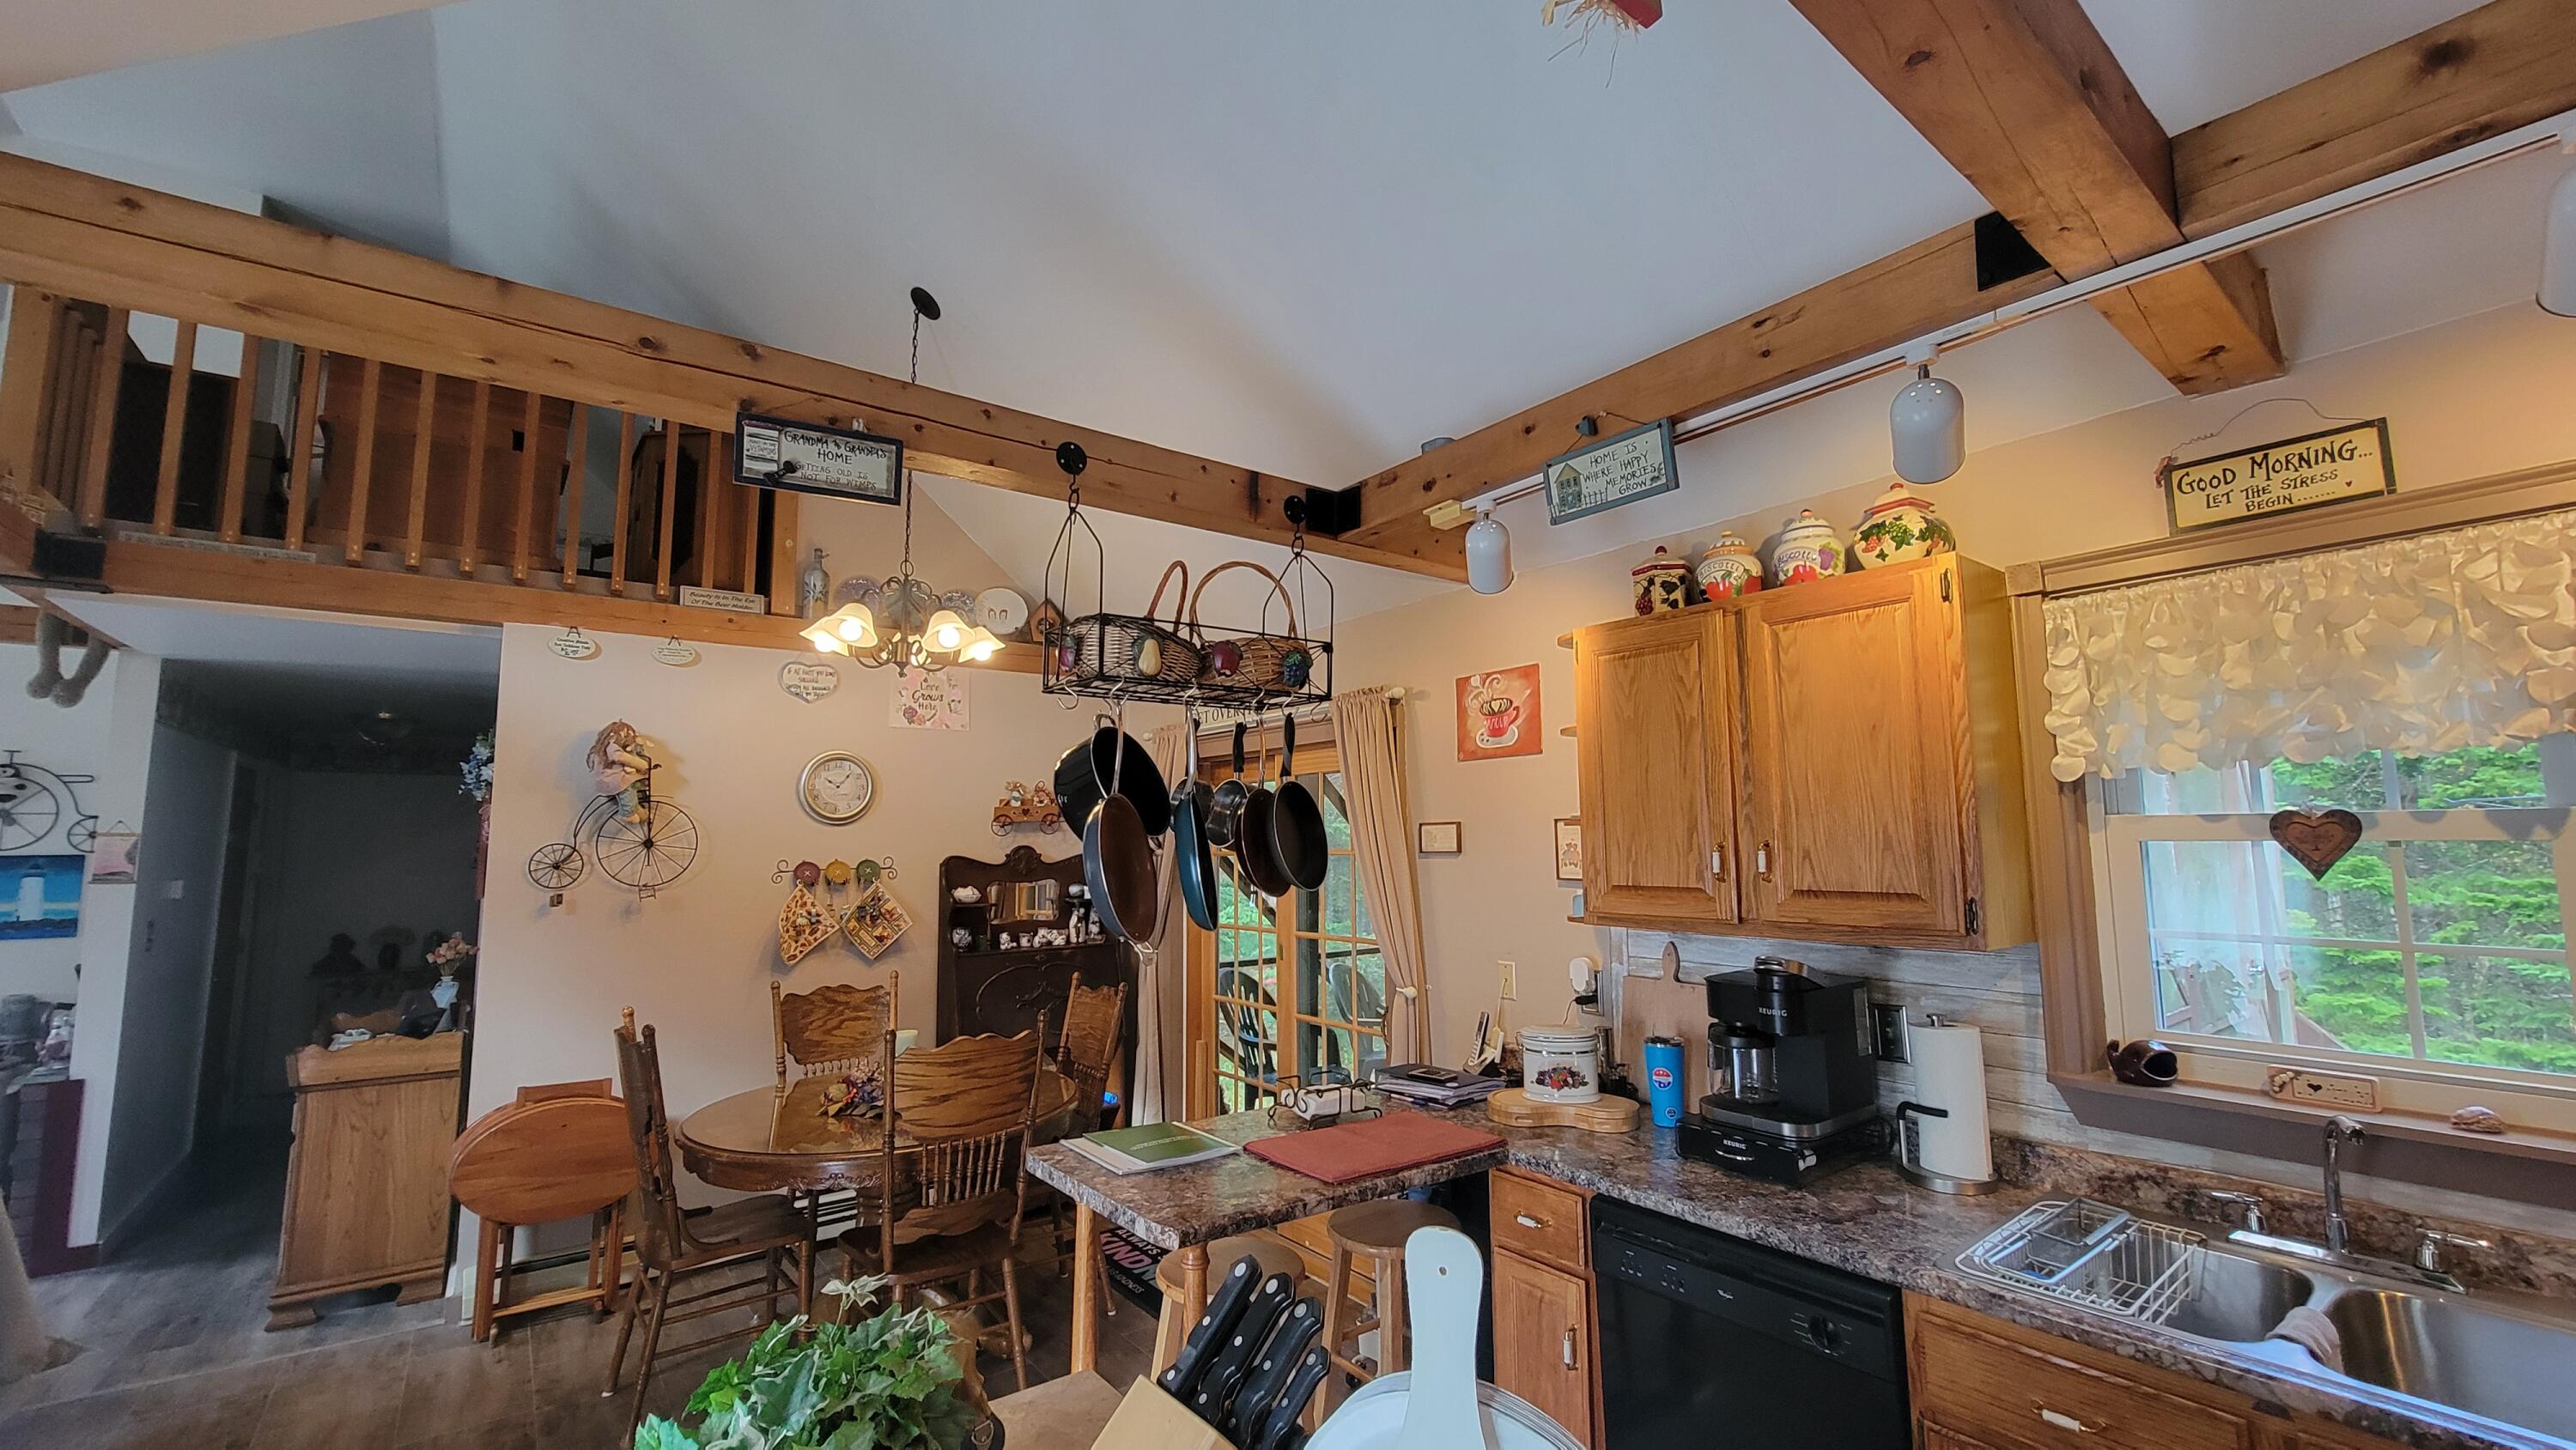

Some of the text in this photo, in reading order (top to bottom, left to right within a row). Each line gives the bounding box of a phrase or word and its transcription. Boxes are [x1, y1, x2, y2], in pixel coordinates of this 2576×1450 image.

[784, 431, 829, 449] GRANDMA
[817, 448, 853, 464] HOME
[1583, 450, 1649, 484] WHERE HAPPY
[1589, 442, 1637, 468] HOME IS
[800, 471, 877, 491] NOT FOR WIMPS
[837, 467, 853, 476] OLD
[858, 471, 869, 481] IS
[1606, 463, 1656, 488] MEMORIES
[1619, 478, 1649, 495] GROW
[2177, 468, 2237, 494] GOOD
[2205, 470, 2338, 509] LET THE STRESS
[912, 689, 944, 703] Grows
[1115, 1229, 1162, 1255] ALWAYS
[1100, 1232, 1161, 1288] KINDN
